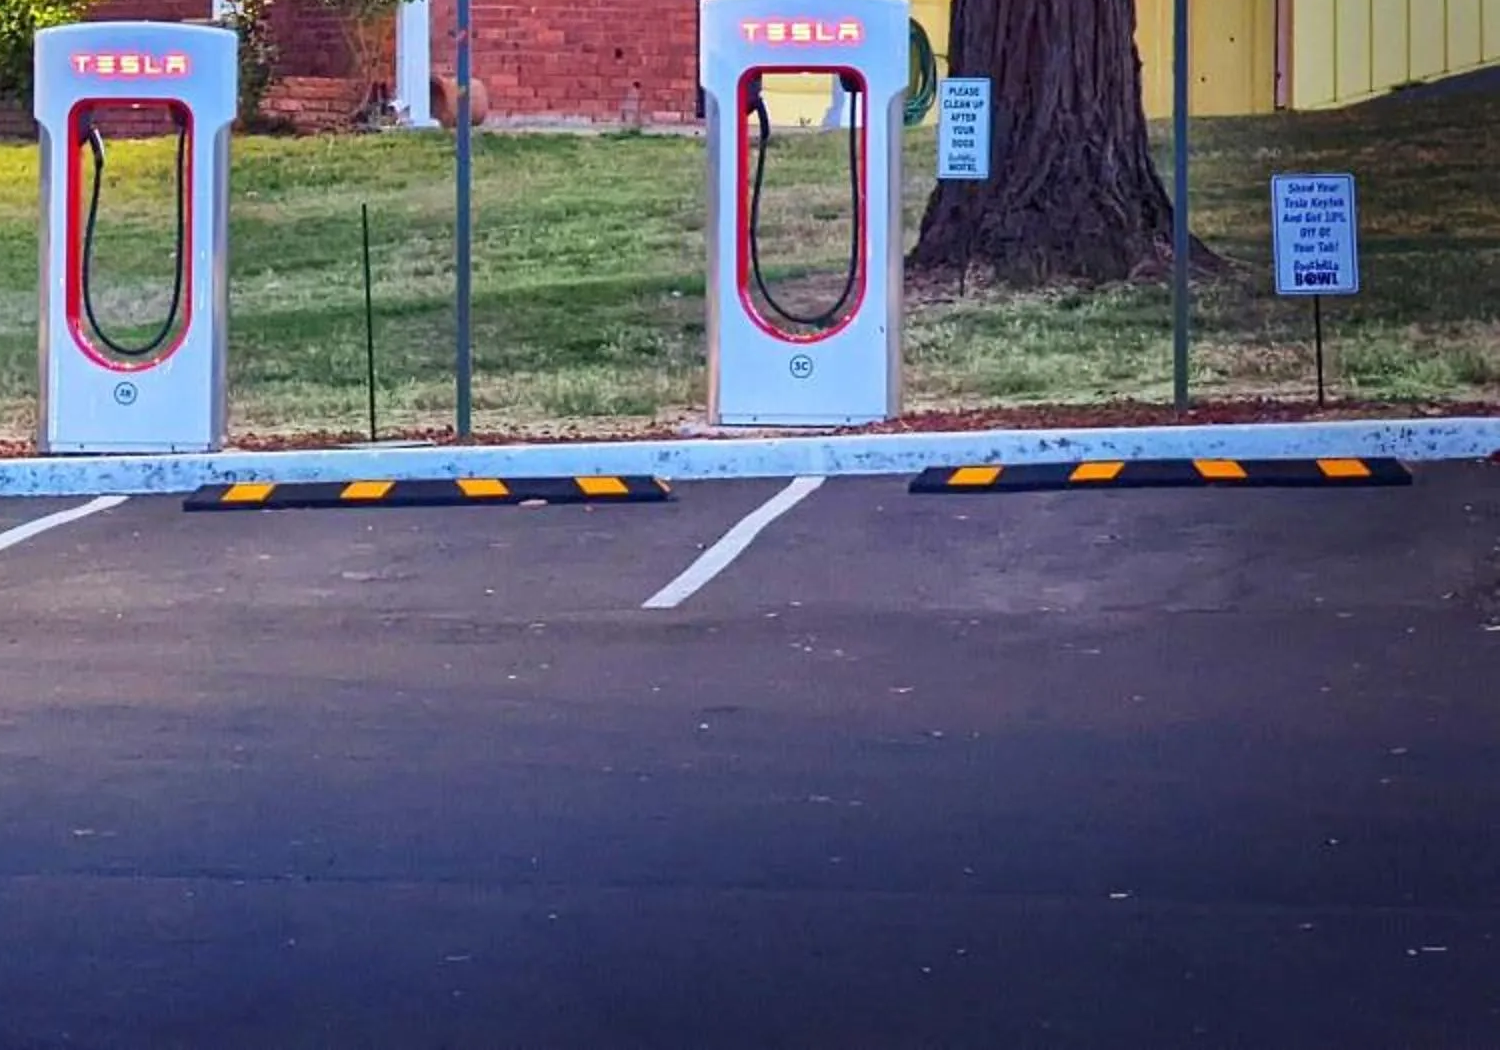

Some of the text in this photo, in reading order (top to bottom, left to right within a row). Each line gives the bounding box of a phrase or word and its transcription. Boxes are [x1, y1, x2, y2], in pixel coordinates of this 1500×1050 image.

[743, 22, 860, 41] TESLA
[73, 55, 186, 73] TESLA
[949, 87, 979, 96] PLEASE
[943, 100, 970, 109] CLEAN
[950, 113, 976, 122] AFTER
[1283, 214, 1302, 223] And
[1295, 272, 1339, 286] BOWL
